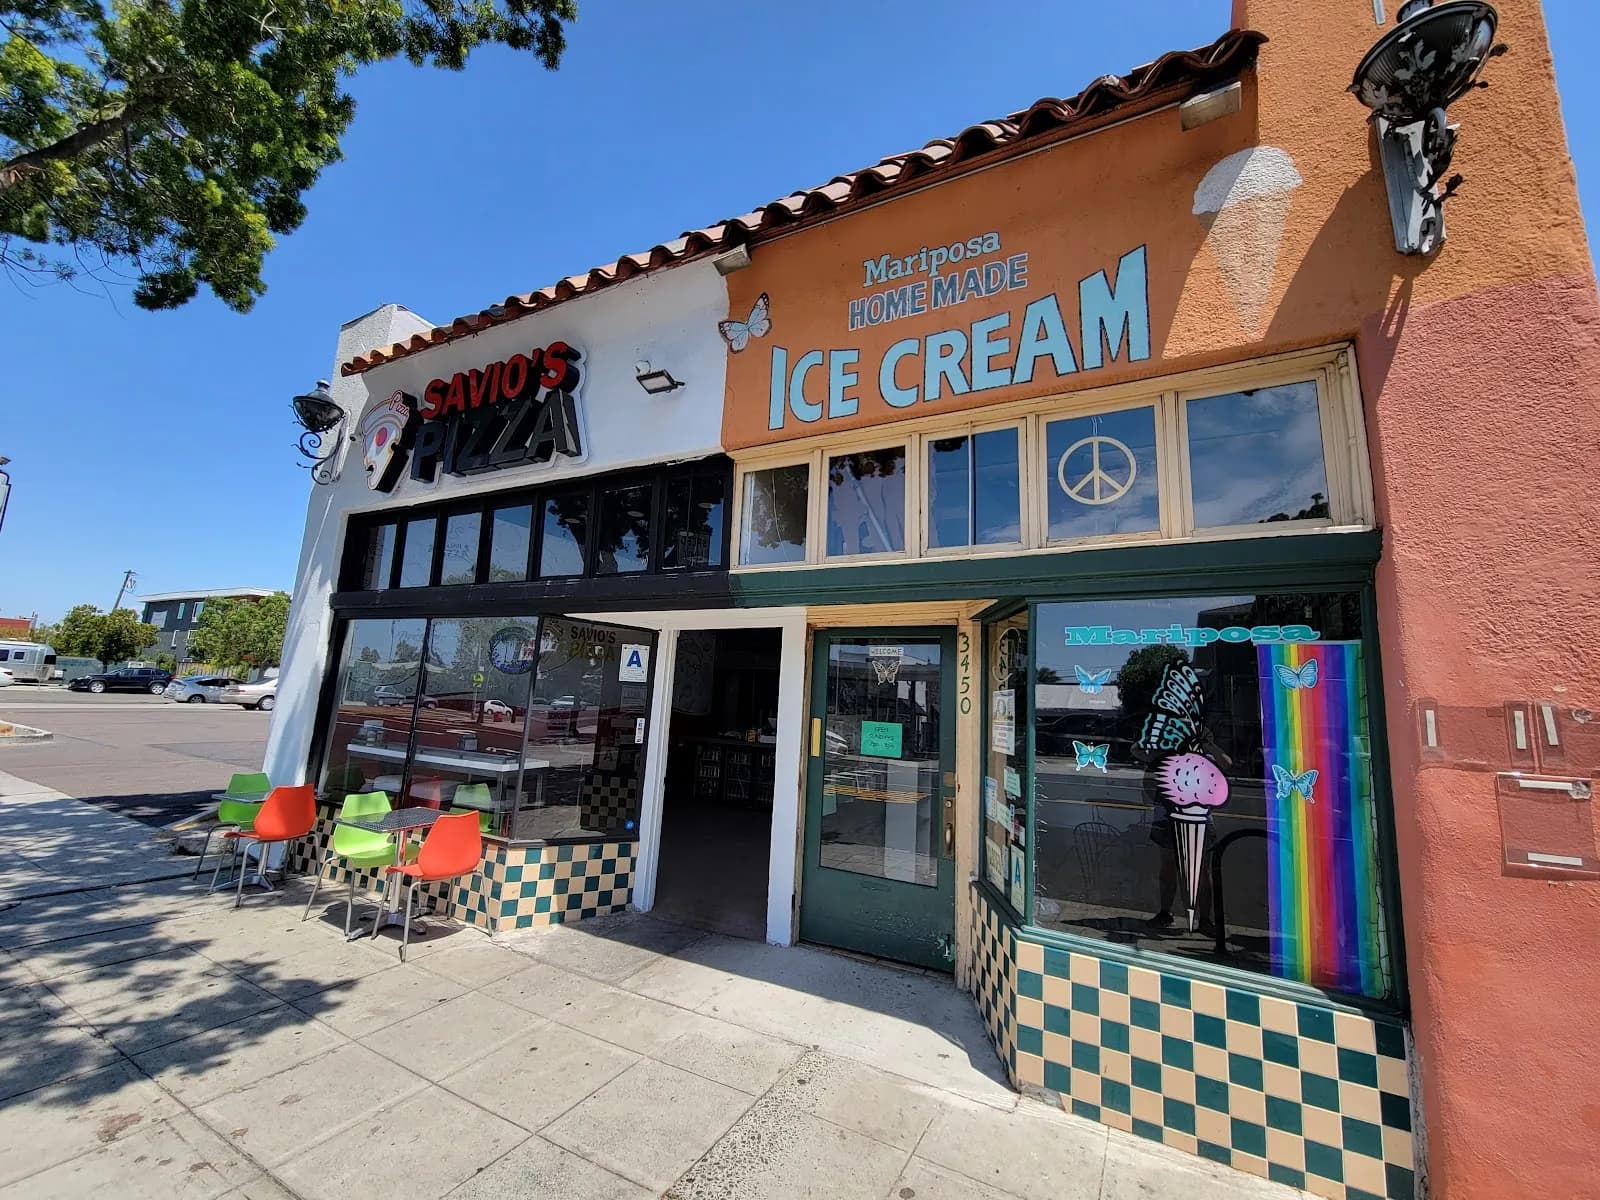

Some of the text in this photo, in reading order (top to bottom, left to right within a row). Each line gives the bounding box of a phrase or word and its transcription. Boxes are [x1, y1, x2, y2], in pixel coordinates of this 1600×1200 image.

[848, 253, 1028, 331] HOME MADE
[863, 231, 1001, 288] Mariposa
[768, 244, 1151, 430] ICE CREAM
[421, 340, 572, 420] SAVIO'S
[410, 388, 580, 484] PIZZA
[570, 625, 616, 644] SAVIO'S
[626, 650, 642, 668] A
[1064, 624, 1320, 647] Mariposa
[957, 632, 972, 715] 3450
[1014, 856, 1022, 889] A
